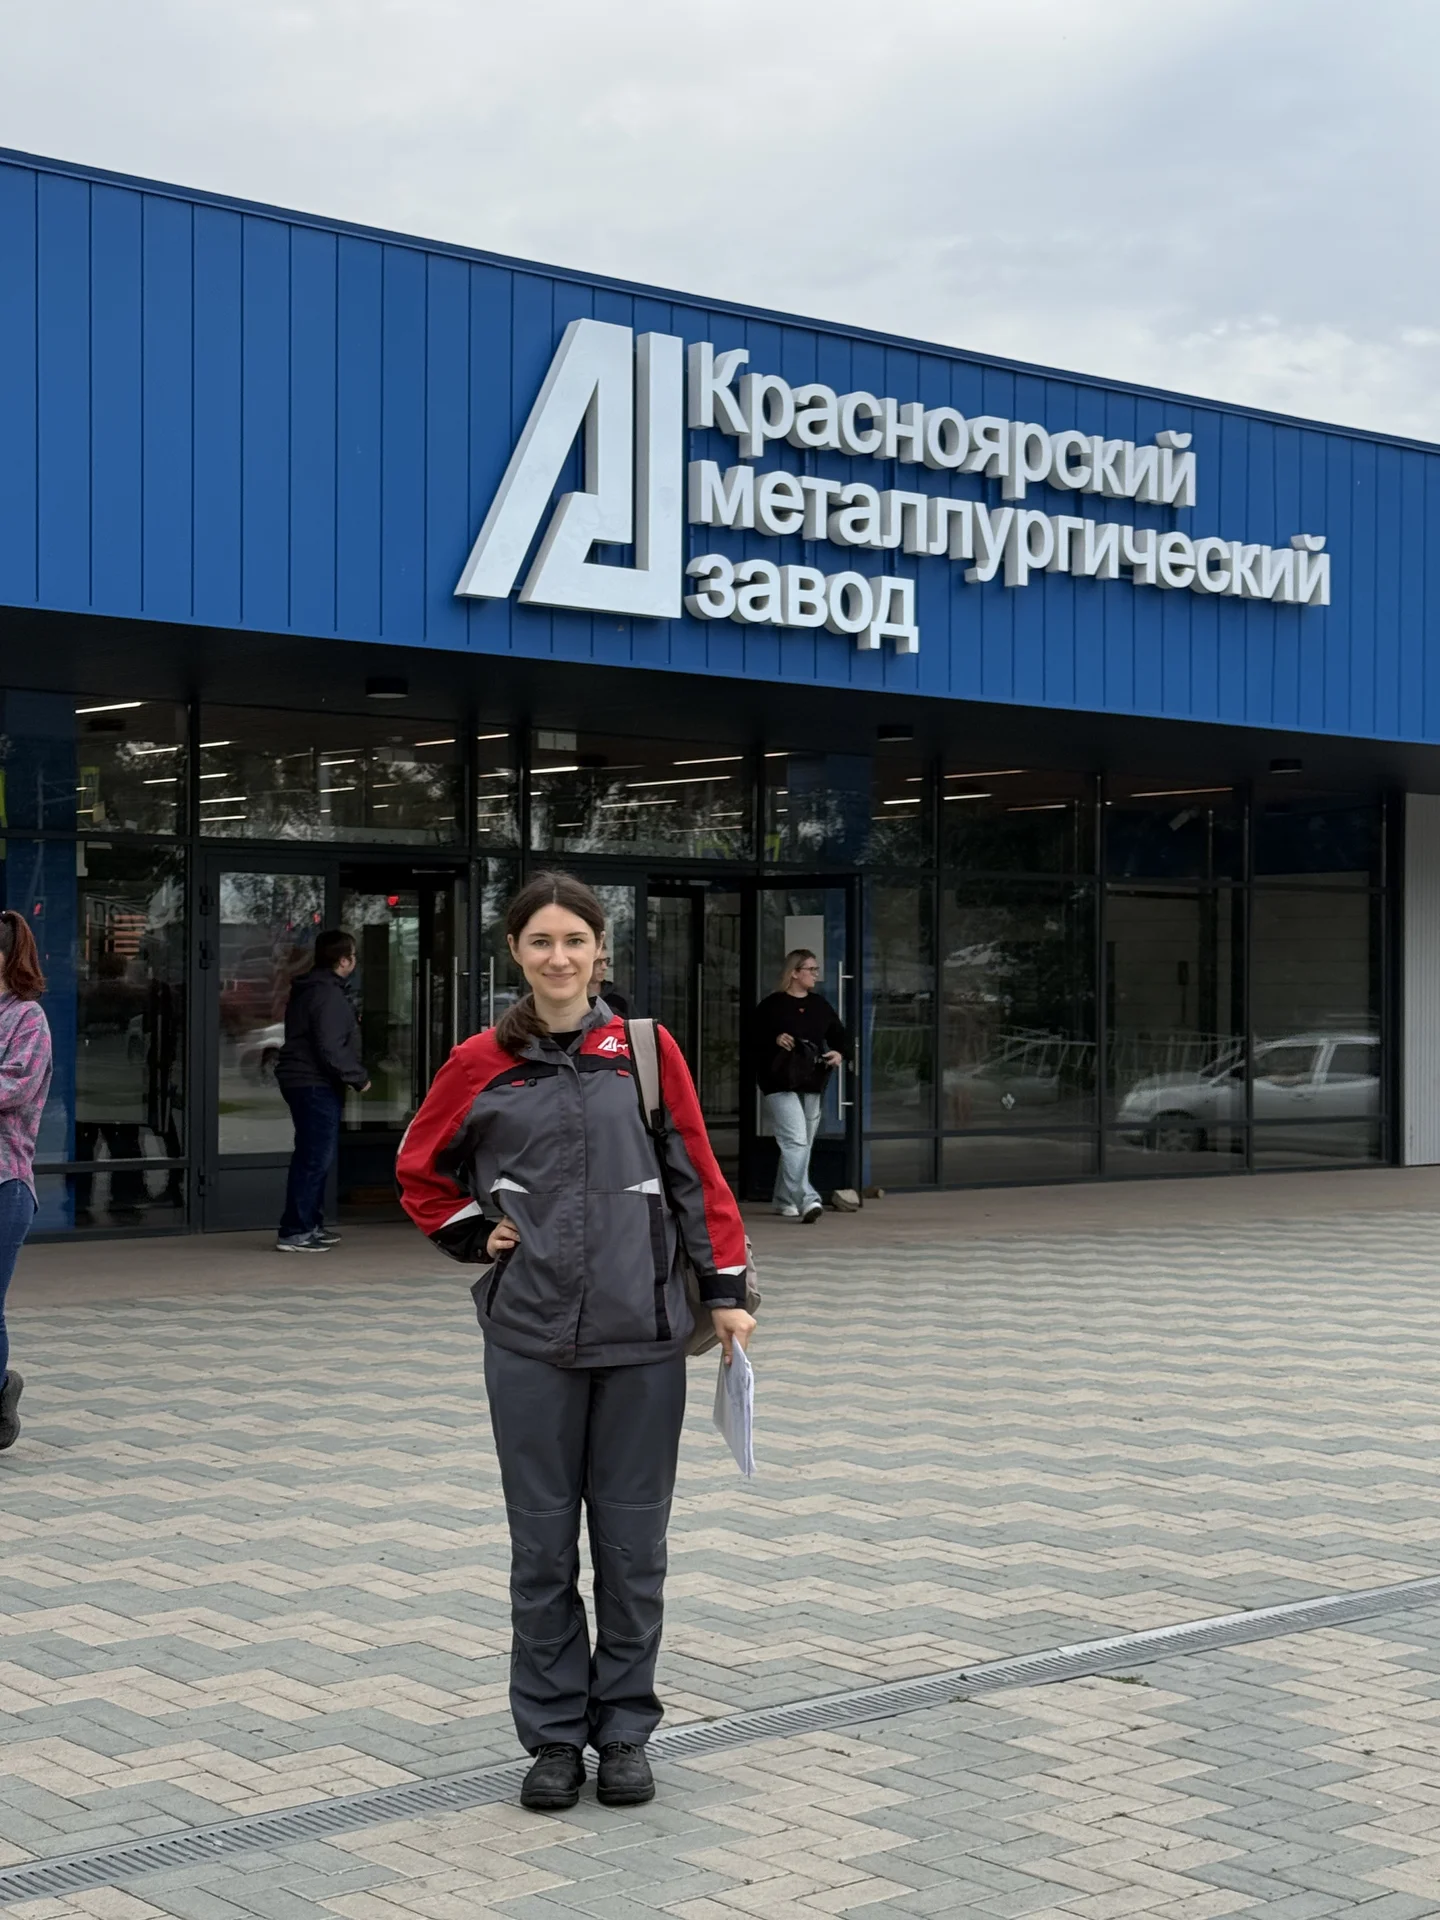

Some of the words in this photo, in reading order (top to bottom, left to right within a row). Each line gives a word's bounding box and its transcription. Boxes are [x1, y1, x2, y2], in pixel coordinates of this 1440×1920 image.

[688, 342, 1196, 507] Красноярский
[685, 553, 919, 654] завод
[688, 459, 1330, 605] металлургический
